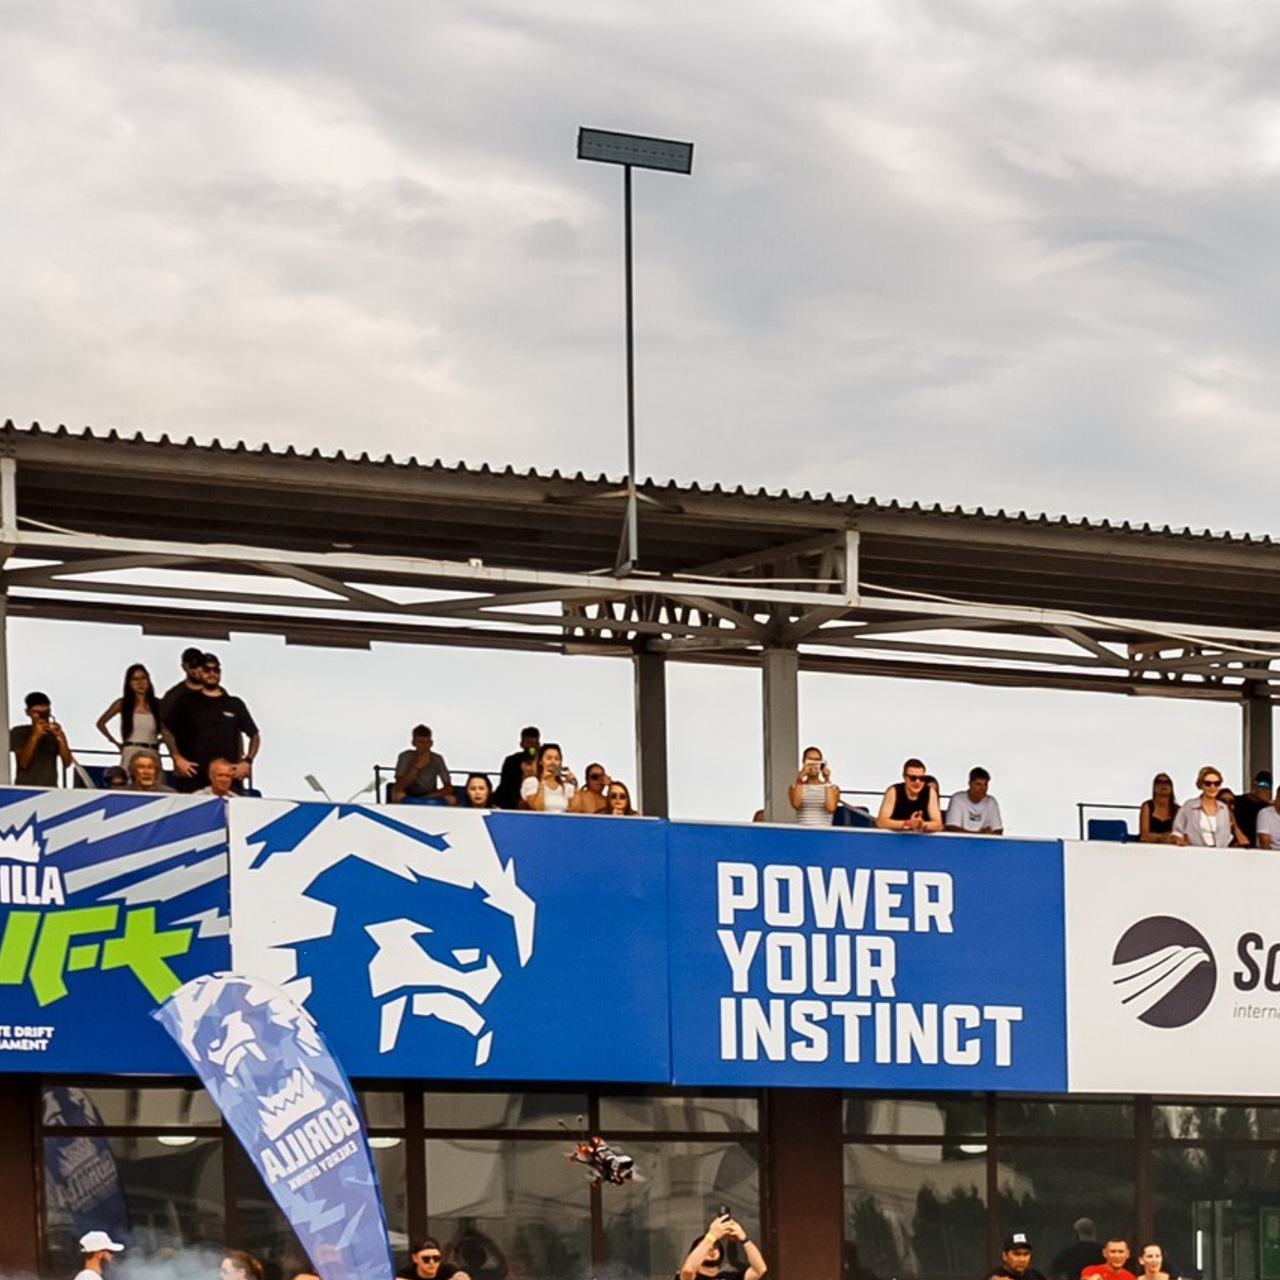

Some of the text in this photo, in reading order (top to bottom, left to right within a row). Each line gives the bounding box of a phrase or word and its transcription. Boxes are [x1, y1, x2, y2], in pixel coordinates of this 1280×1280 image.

[717, 861, 954, 934] POWER
[716, 929, 896, 997] YOUR
[0, 1039, 49, 1051] AMENT
[720, 997, 1024, 1067] INSTINCT
